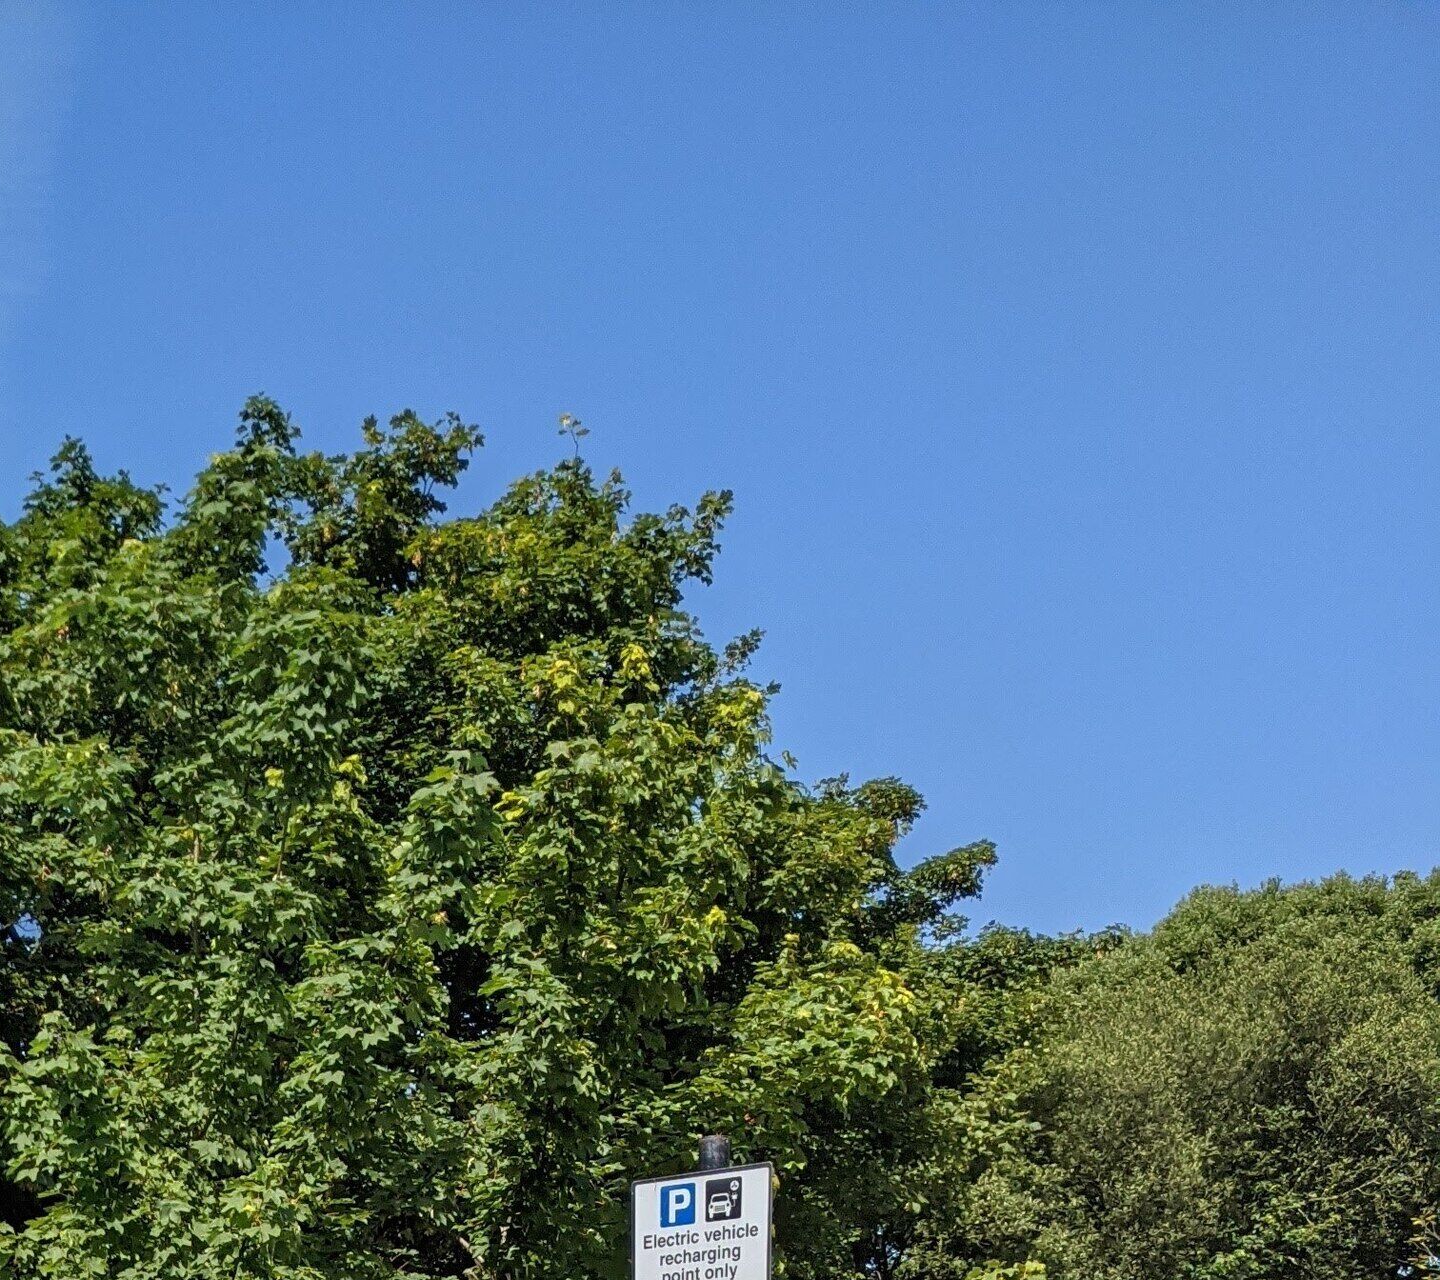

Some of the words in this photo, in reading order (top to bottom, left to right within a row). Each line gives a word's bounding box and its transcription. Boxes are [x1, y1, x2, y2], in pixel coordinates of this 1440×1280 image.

[669, 1188, 691, 1223] P
[643, 1230, 699, 1249] Electric
[705, 1223, 758, 1242] vehicle
[659, 1246, 741, 1266] recharging
[705, 1263, 738, 1280] only
